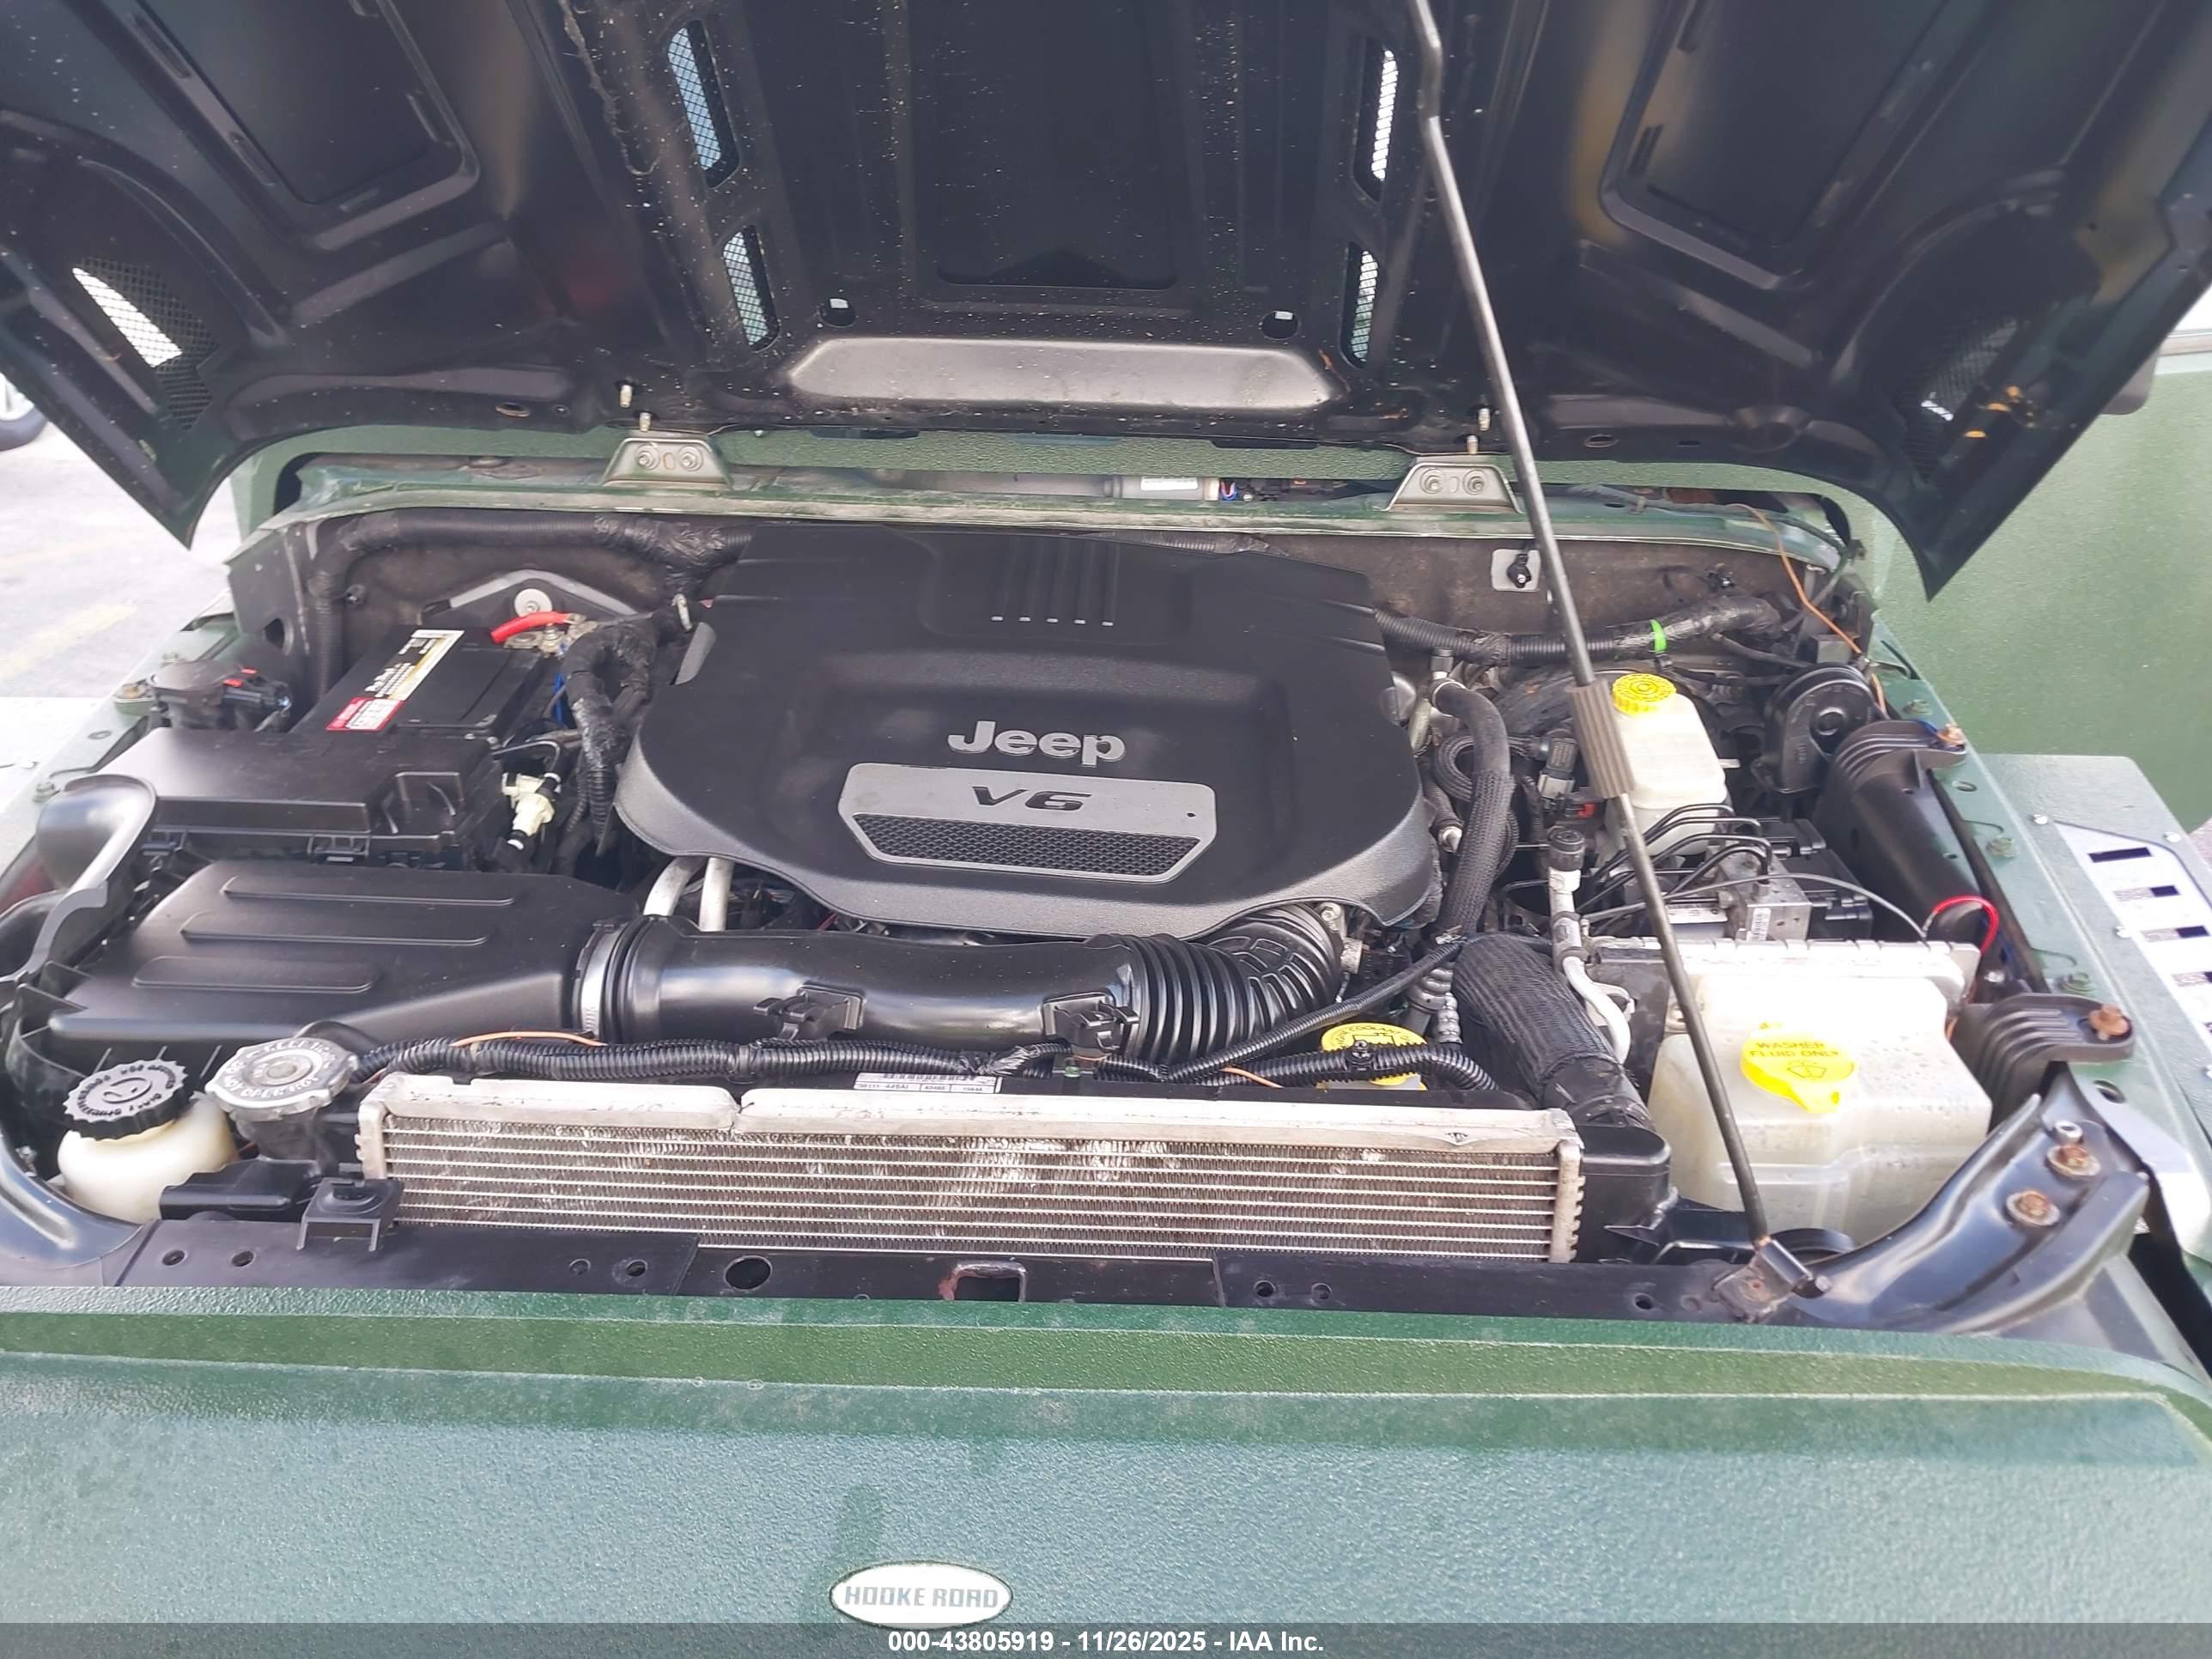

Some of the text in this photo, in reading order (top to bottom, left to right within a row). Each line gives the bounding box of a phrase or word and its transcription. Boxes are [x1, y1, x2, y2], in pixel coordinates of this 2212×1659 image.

[947, 720, 1126, 768] Jeep
[972, 786, 1093, 811] V6
[844, 1586, 999, 1608] HOOKE ROAD
